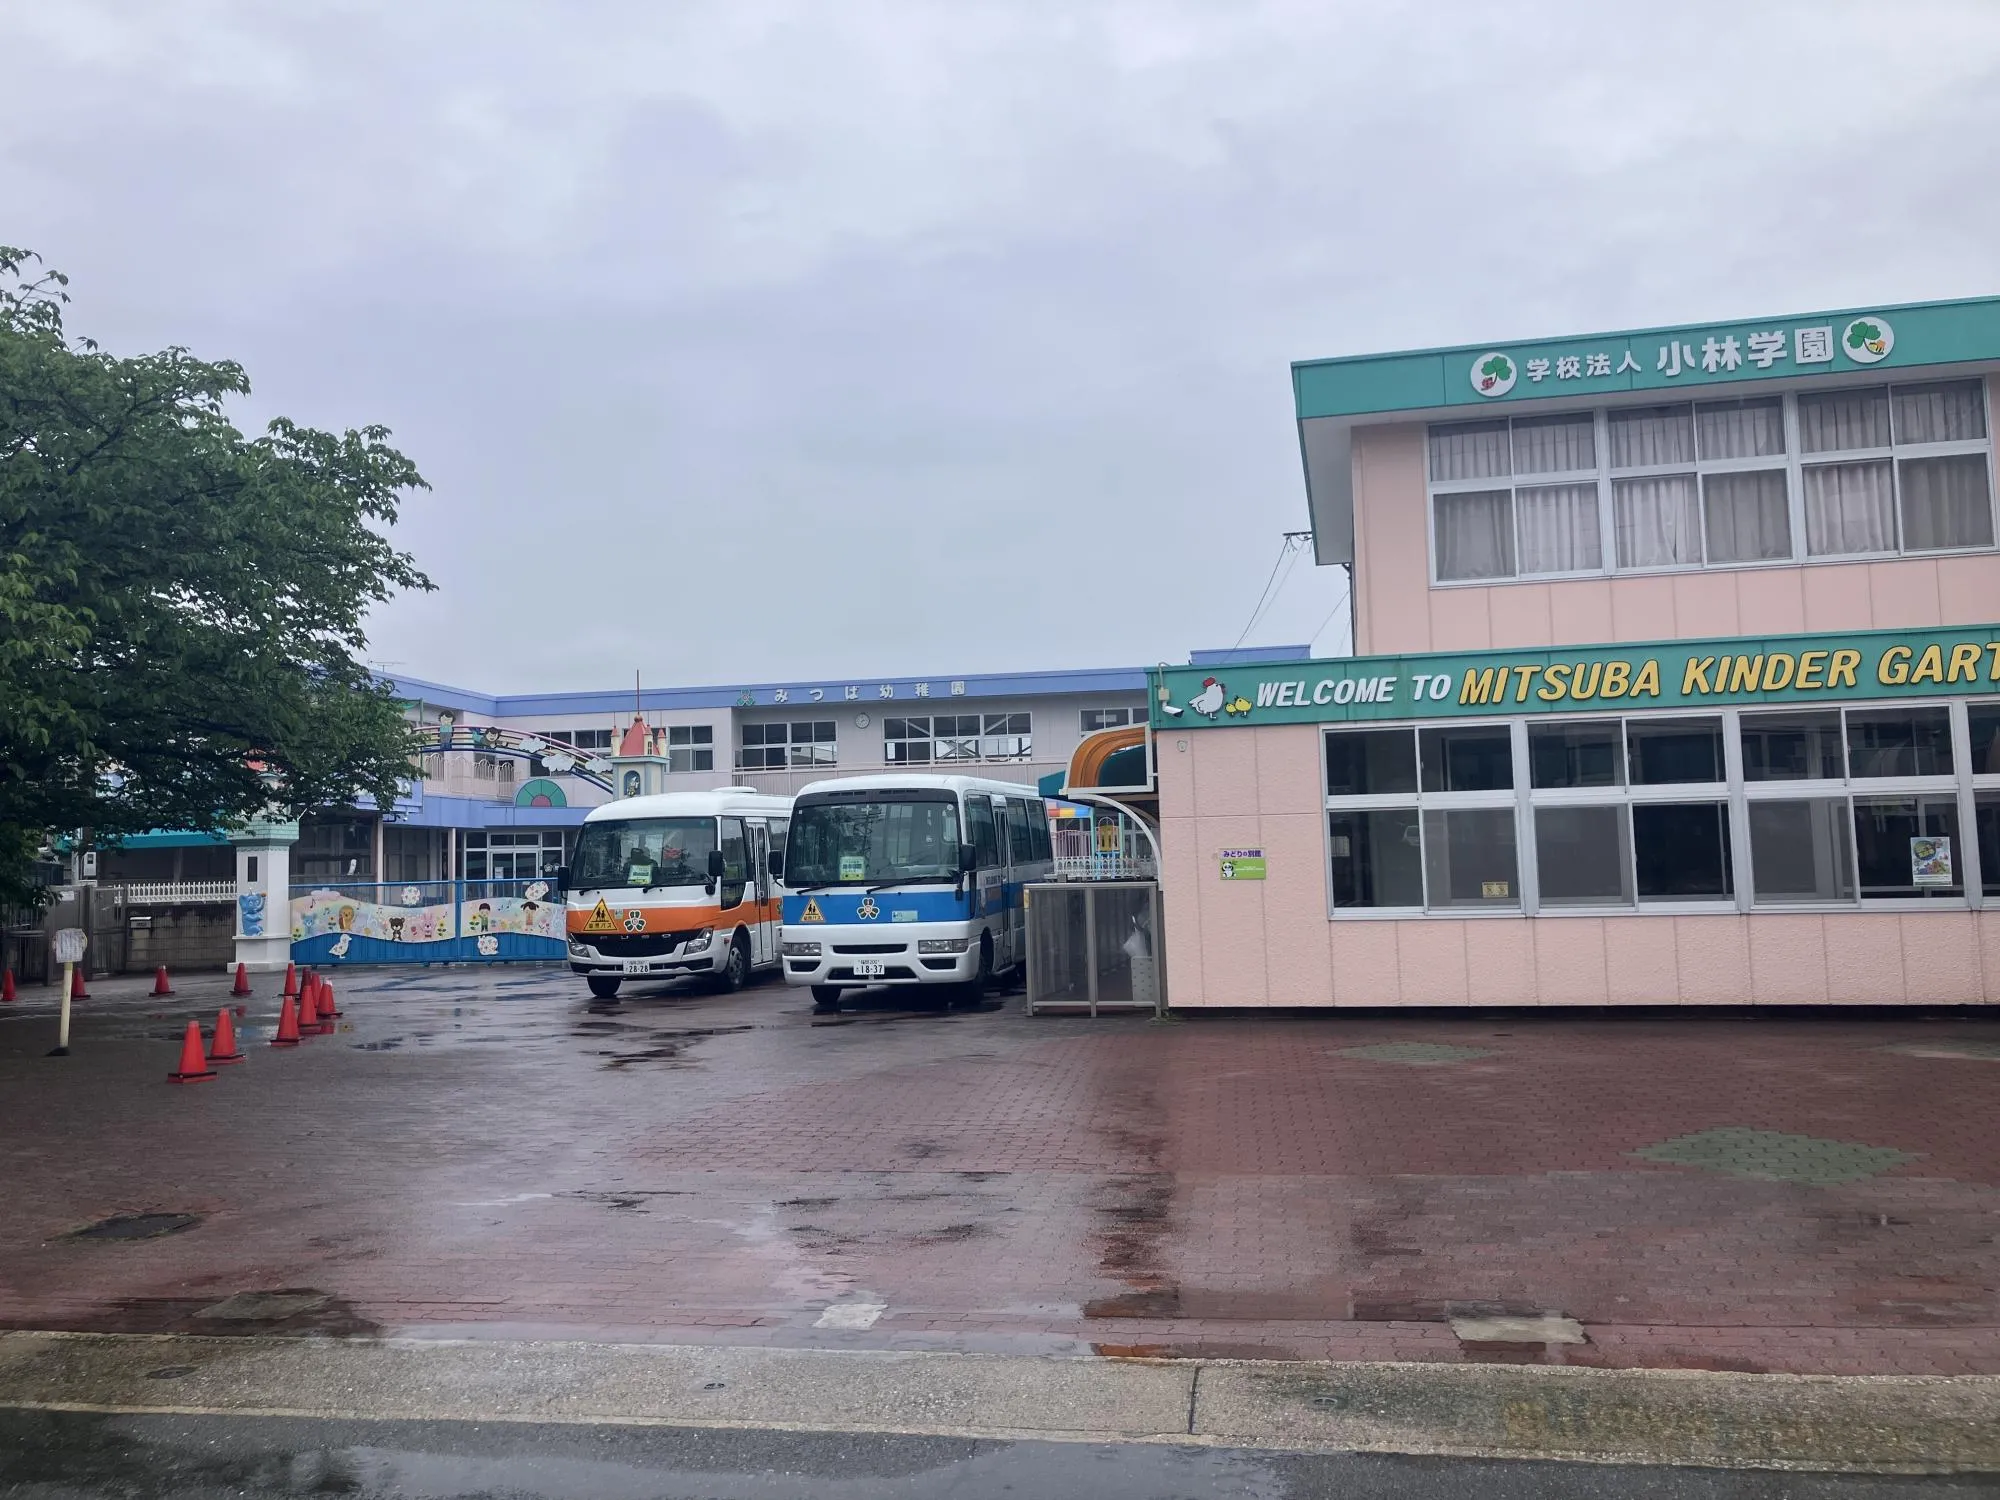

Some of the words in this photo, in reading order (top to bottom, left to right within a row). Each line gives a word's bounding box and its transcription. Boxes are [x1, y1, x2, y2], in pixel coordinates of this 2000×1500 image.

[1526, 350, 1642, 382] 学校法人
[1657, 325, 1835, 377] 小林学園
[773, 680, 966, 703] みつば幼稚園
[1256, 676, 1397, 707] WELCOME
[1412, 673, 1451, 700] TO
[1458, 658, 1661, 706] MITSUBA
[1681, 649, 1862, 696] KINDER
[861, 964, 883, 974] 18-37
